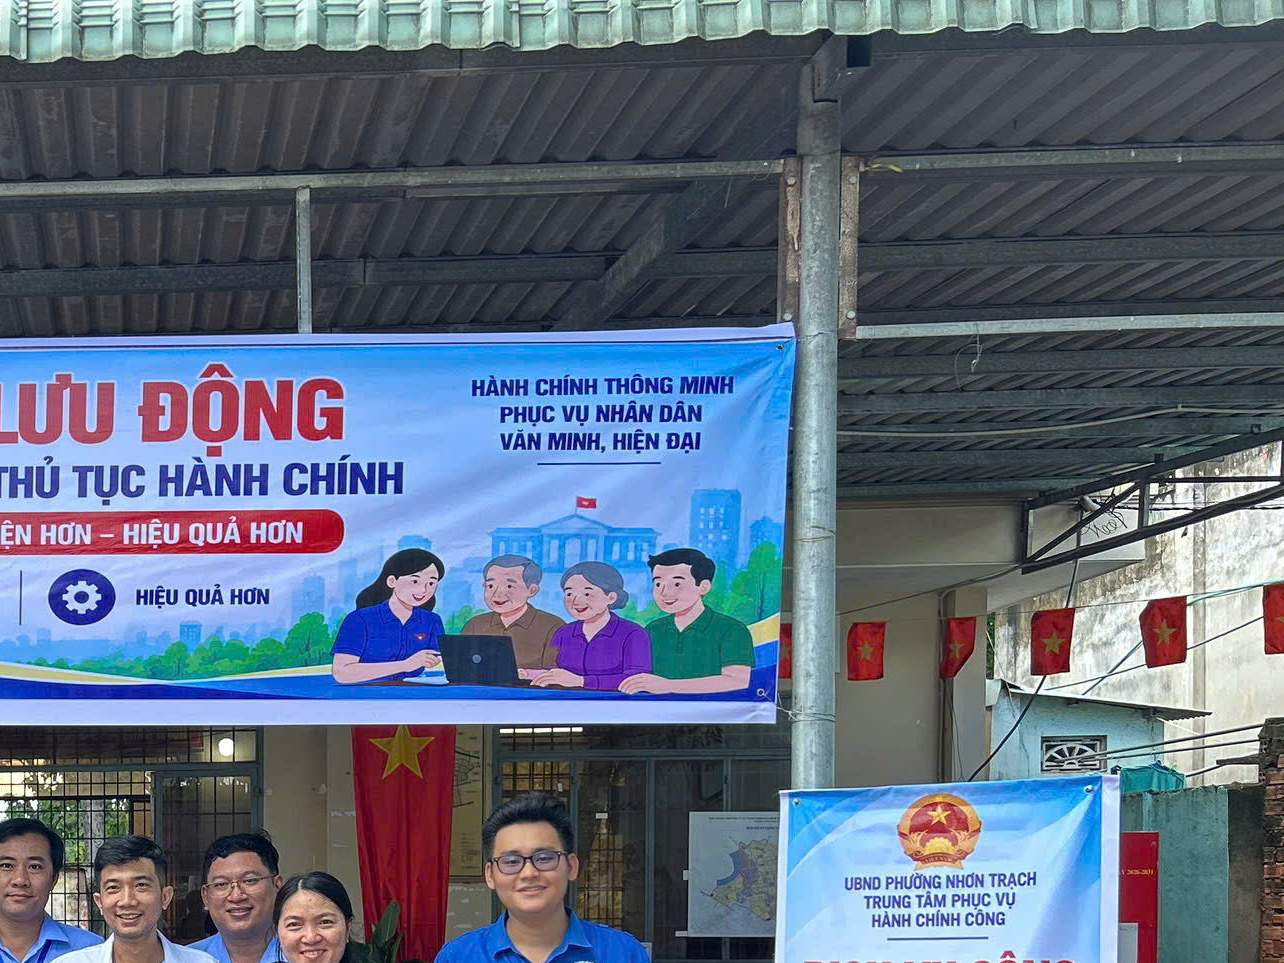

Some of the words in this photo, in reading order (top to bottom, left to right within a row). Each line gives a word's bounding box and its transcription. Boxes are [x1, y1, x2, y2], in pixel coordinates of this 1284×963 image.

[472, 375, 528, 396] HÀNH
[534, 374, 598, 396] CHÍNH
[603, 373, 673, 395] THÔNG
[679, 374, 735, 395] MINH
[137, 364, 344, 458] ĐỘNG
[500, 405, 555, 426] PHỤC
[561, 405, 589, 426] VỤ
[596, 401, 654, 422] NHÂN
[659, 399, 702, 422] DÂN
[500, 429, 541, 450] VĂN
[548, 433, 605, 453] MINH,
[613, 429, 659, 454] HIỆN
[666, 432, 701, 454] ĐẠI
[72, 465, 145, 506] TỤC
[159, 457, 269, 497] HÀNH
[283, 454, 403, 496] CHÍNH
[41, 522, 91, 545] HƠN
[124, 519, 180, 548] HIỆU
[189, 516, 240, 546] QUẢ
[251, 520, 303, 544] HƠN
[136, 586, 178, 609] HIỆU
[185, 584, 224, 607] QUẢ
[230, 588, 269, 605] HƠN
